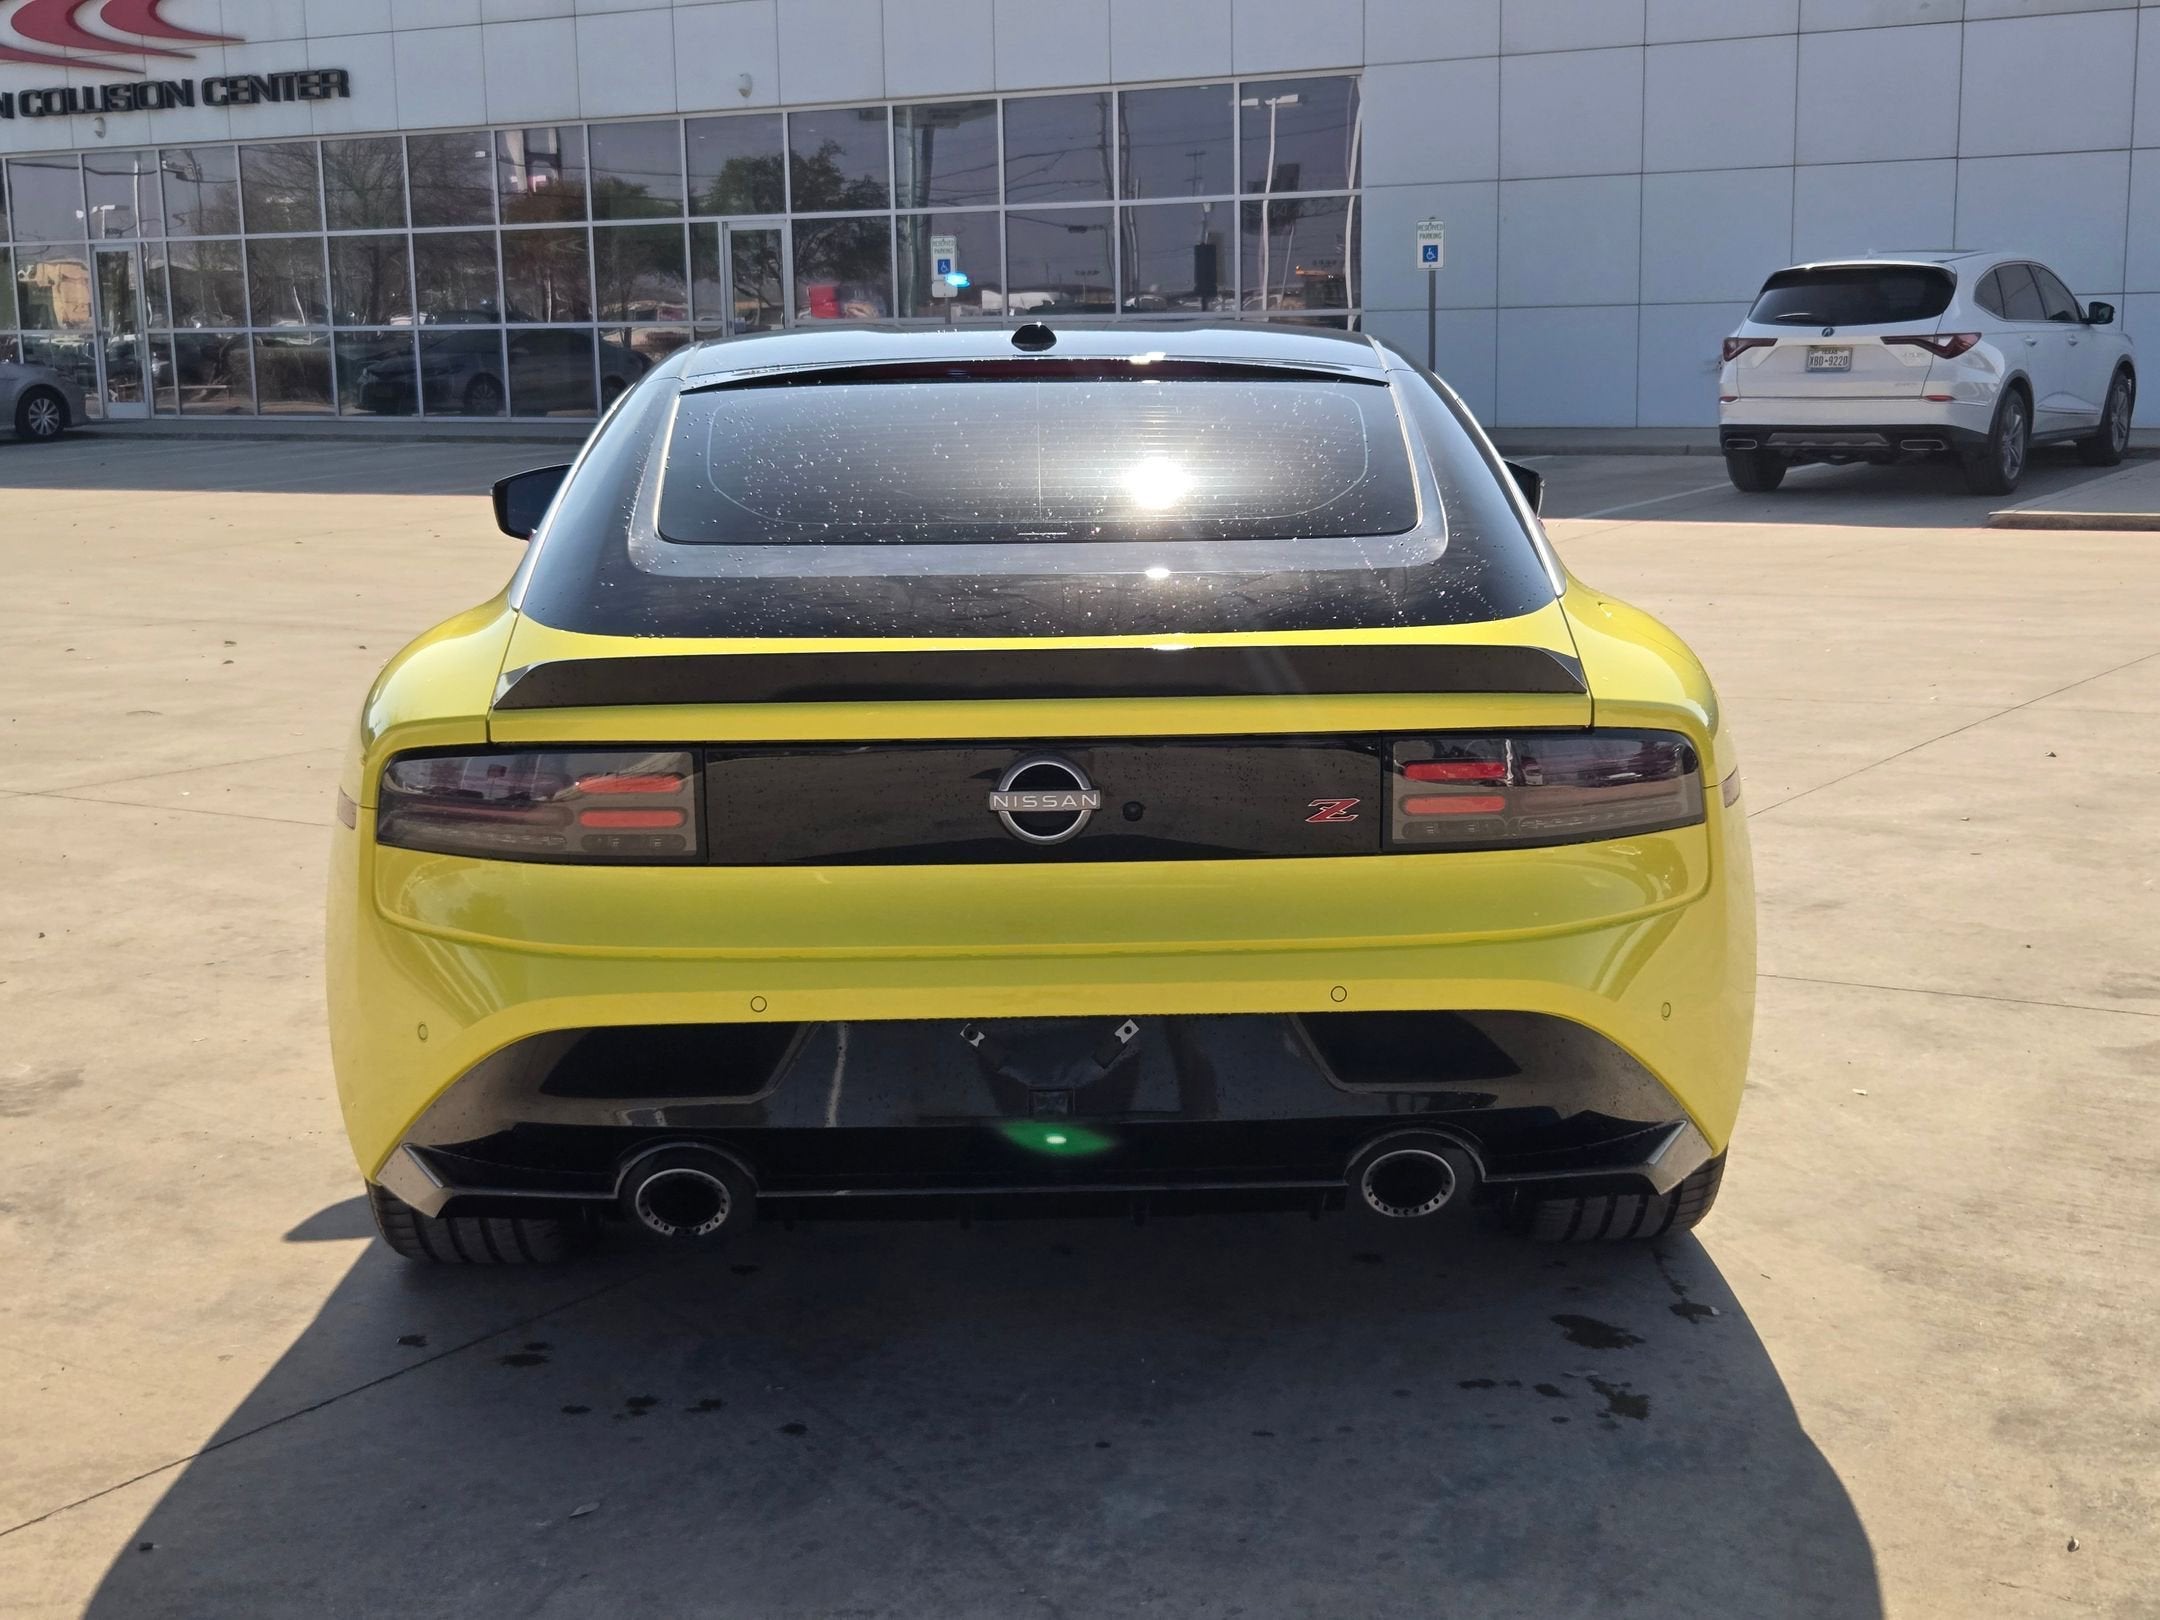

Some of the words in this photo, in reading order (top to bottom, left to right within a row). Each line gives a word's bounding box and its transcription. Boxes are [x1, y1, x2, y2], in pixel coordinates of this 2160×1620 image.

[18, 79, 195, 117] COLLISION
[202, 69, 350, 106] CENTER
[1419, 232, 1442, 240] PARKING
[993, 794, 1097, 808] NISSAN
[1305, 798, 1360, 823] Z
